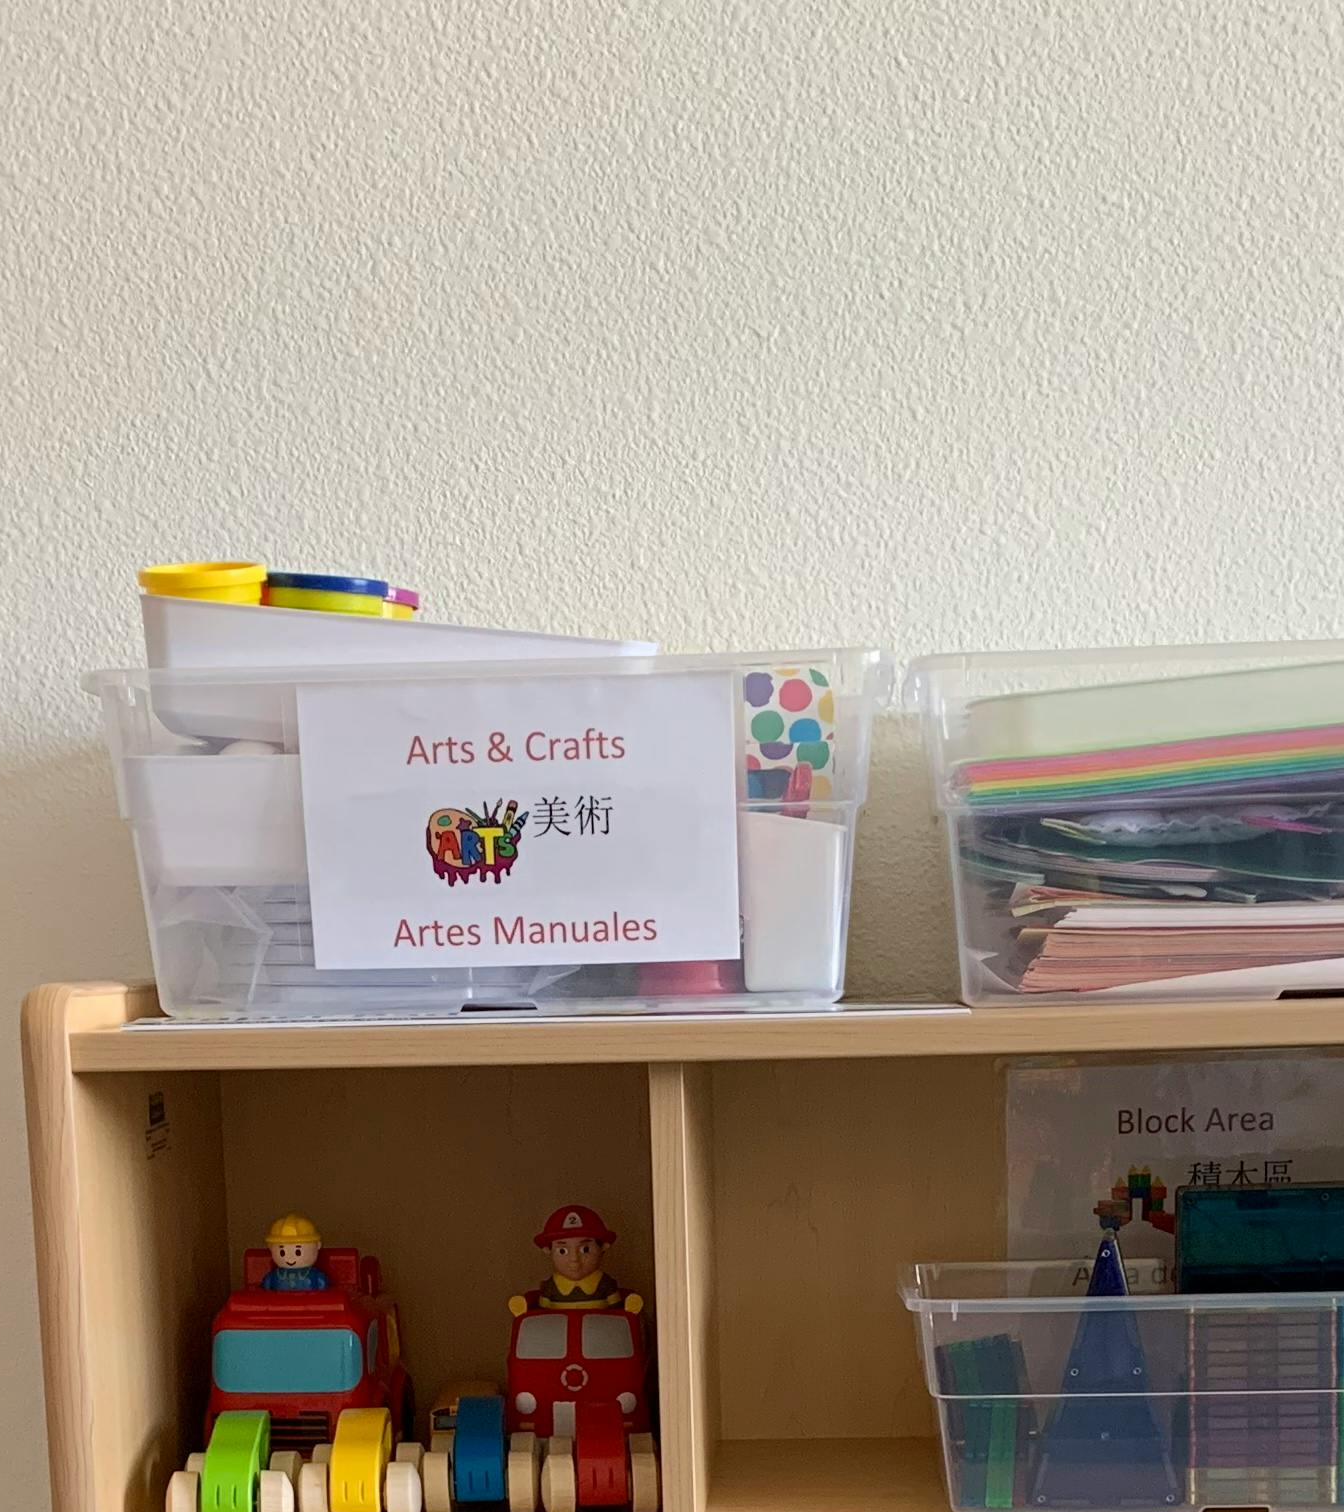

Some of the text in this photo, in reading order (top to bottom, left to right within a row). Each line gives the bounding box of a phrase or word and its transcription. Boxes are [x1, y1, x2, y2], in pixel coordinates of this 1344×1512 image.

[406, 728, 626, 765] Arts & Crafts
[533, 795, 614, 838] 美術
[435, 826, 518, 866] ARTS
[393, 911, 657, 947] Artes Manuales
[1117, 1107, 1275, 1135] Block Area
[1151, 1260, 1176, 1285] d
